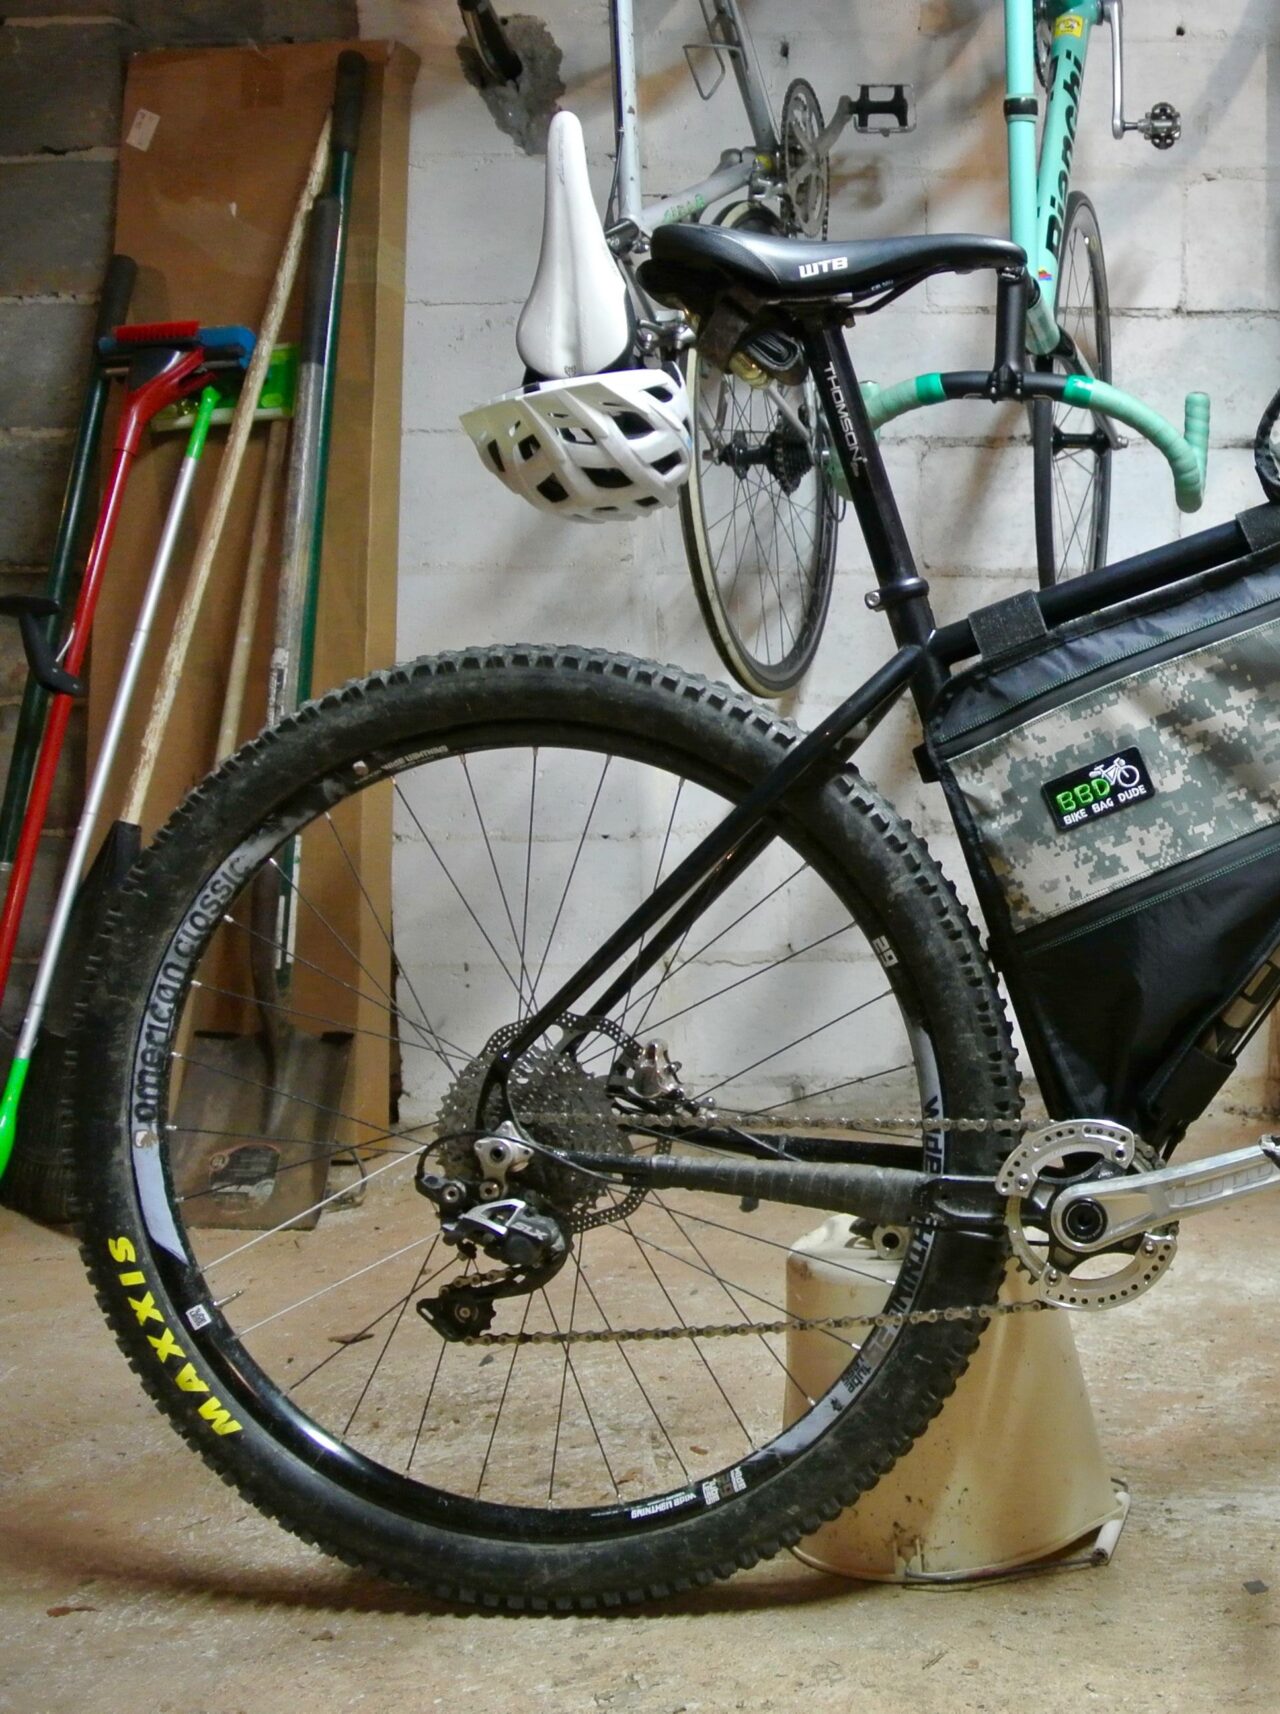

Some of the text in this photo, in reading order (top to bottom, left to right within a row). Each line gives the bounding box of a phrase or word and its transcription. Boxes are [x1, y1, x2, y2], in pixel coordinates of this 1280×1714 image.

[799, 256, 848, 279] WTB
[824, 361, 864, 462] THOMSON
[1056, 778, 1110, 811] BBD
[1063, 784, 1147, 825] BIKE BAG DUDE
[872, 935, 899, 967] 29
[511, 1221, 548, 1241] SLX
[108, 1236, 243, 1436] MAXXIS
